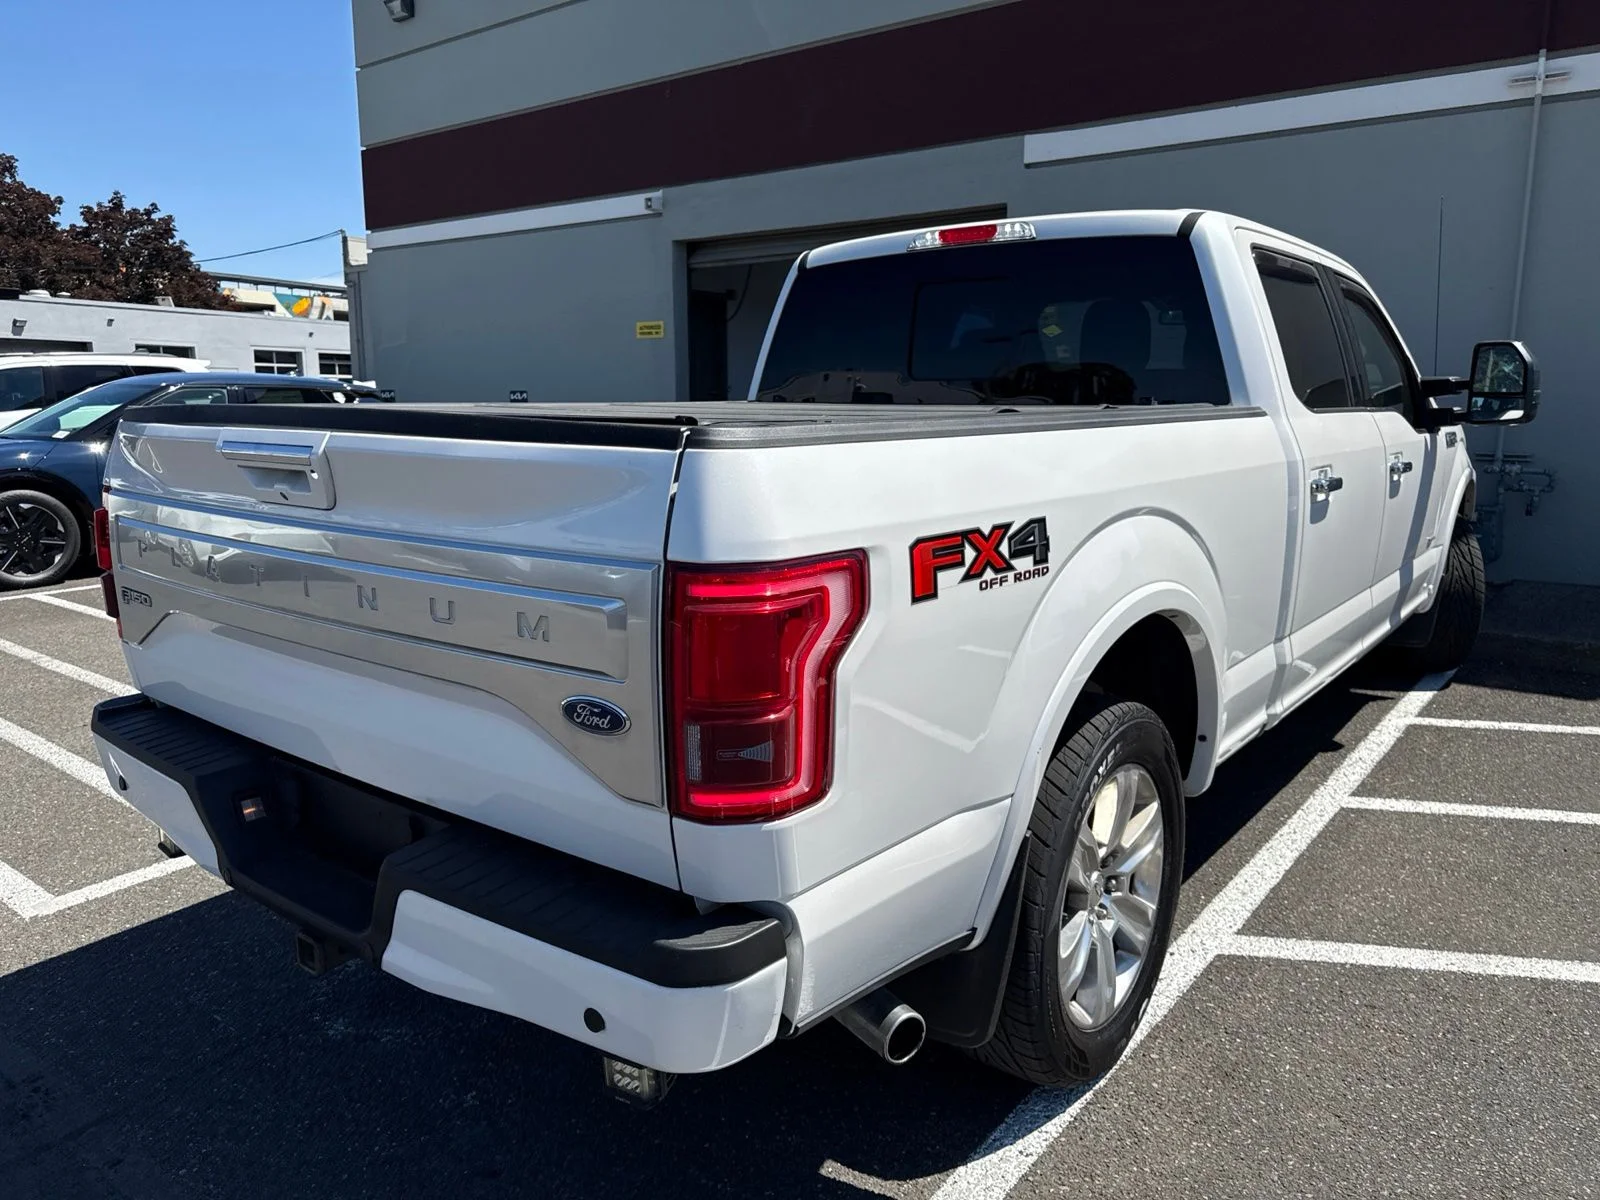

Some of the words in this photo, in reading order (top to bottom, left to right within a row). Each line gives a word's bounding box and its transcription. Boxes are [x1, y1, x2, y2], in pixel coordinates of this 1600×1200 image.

[137, 538, 550, 642] PLATINUM
[908, 515, 1050, 606] FX4
[979, 574, 1009, 592] OFF
[1013, 566, 1050, 584] ROAD
[573, 703, 611, 730] Ford
